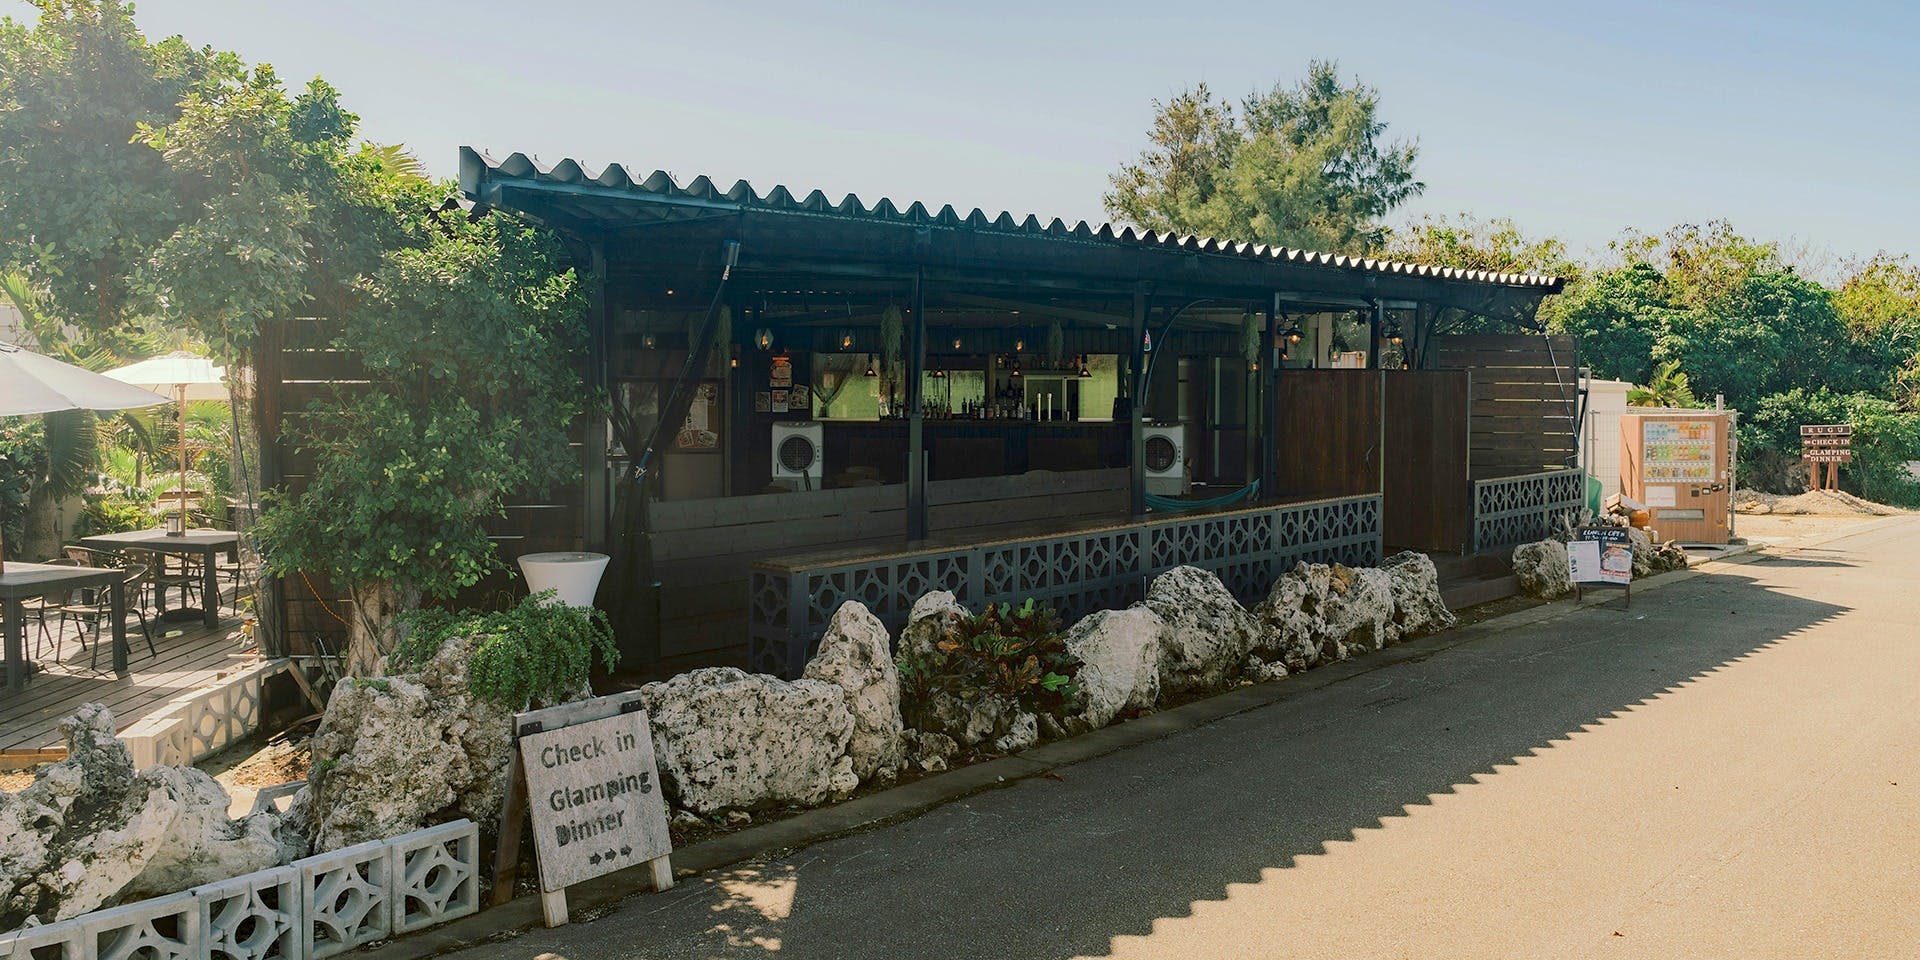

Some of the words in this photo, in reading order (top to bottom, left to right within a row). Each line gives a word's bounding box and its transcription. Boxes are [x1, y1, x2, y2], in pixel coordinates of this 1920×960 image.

[541, 736, 606, 769] Check
[616, 731, 635, 751] in
[550, 771, 652, 812] Glamping
[555, 810, 624, 847] Dinner
